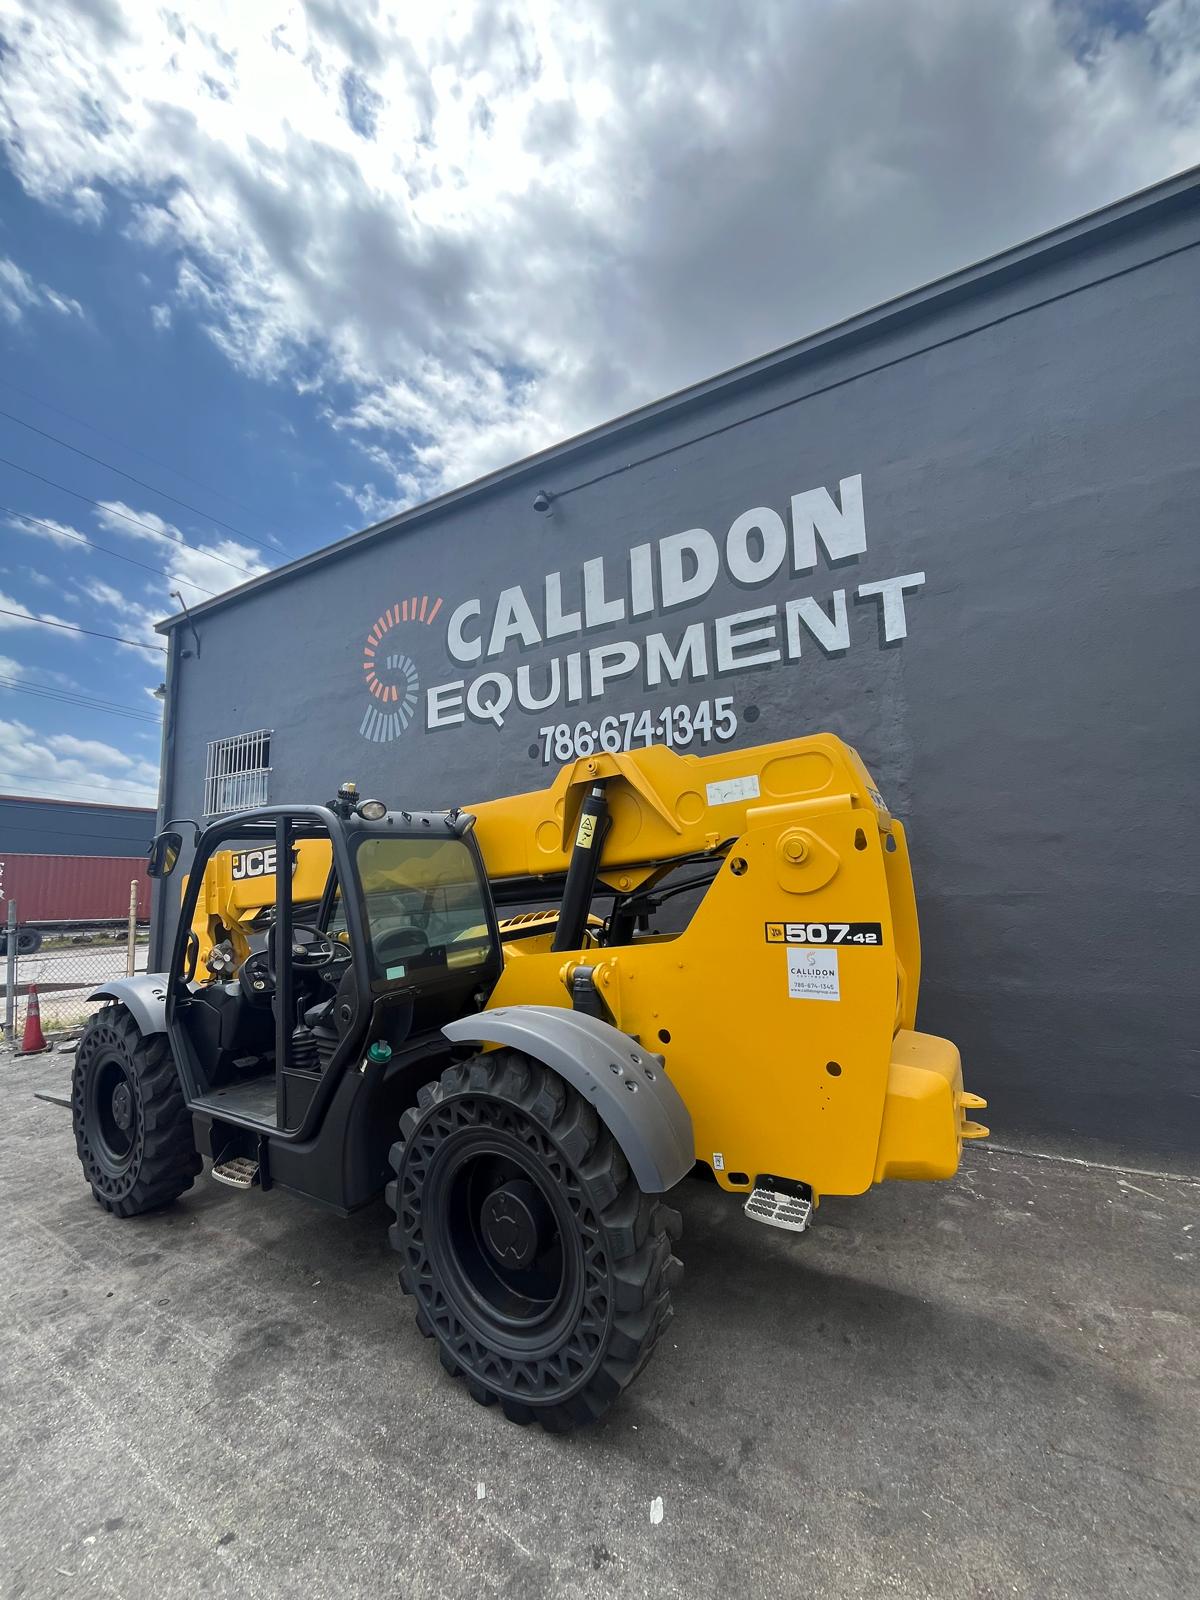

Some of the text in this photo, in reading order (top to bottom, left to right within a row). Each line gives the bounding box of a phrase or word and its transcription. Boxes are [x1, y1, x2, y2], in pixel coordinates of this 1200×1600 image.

[447, 474, 867, 661] CALLIDON
[427, 572, 926, 728] EQUIPMENT
[786, 924, 877, 943] 507-42
[790, 967, 835, 976] CALLIDON
